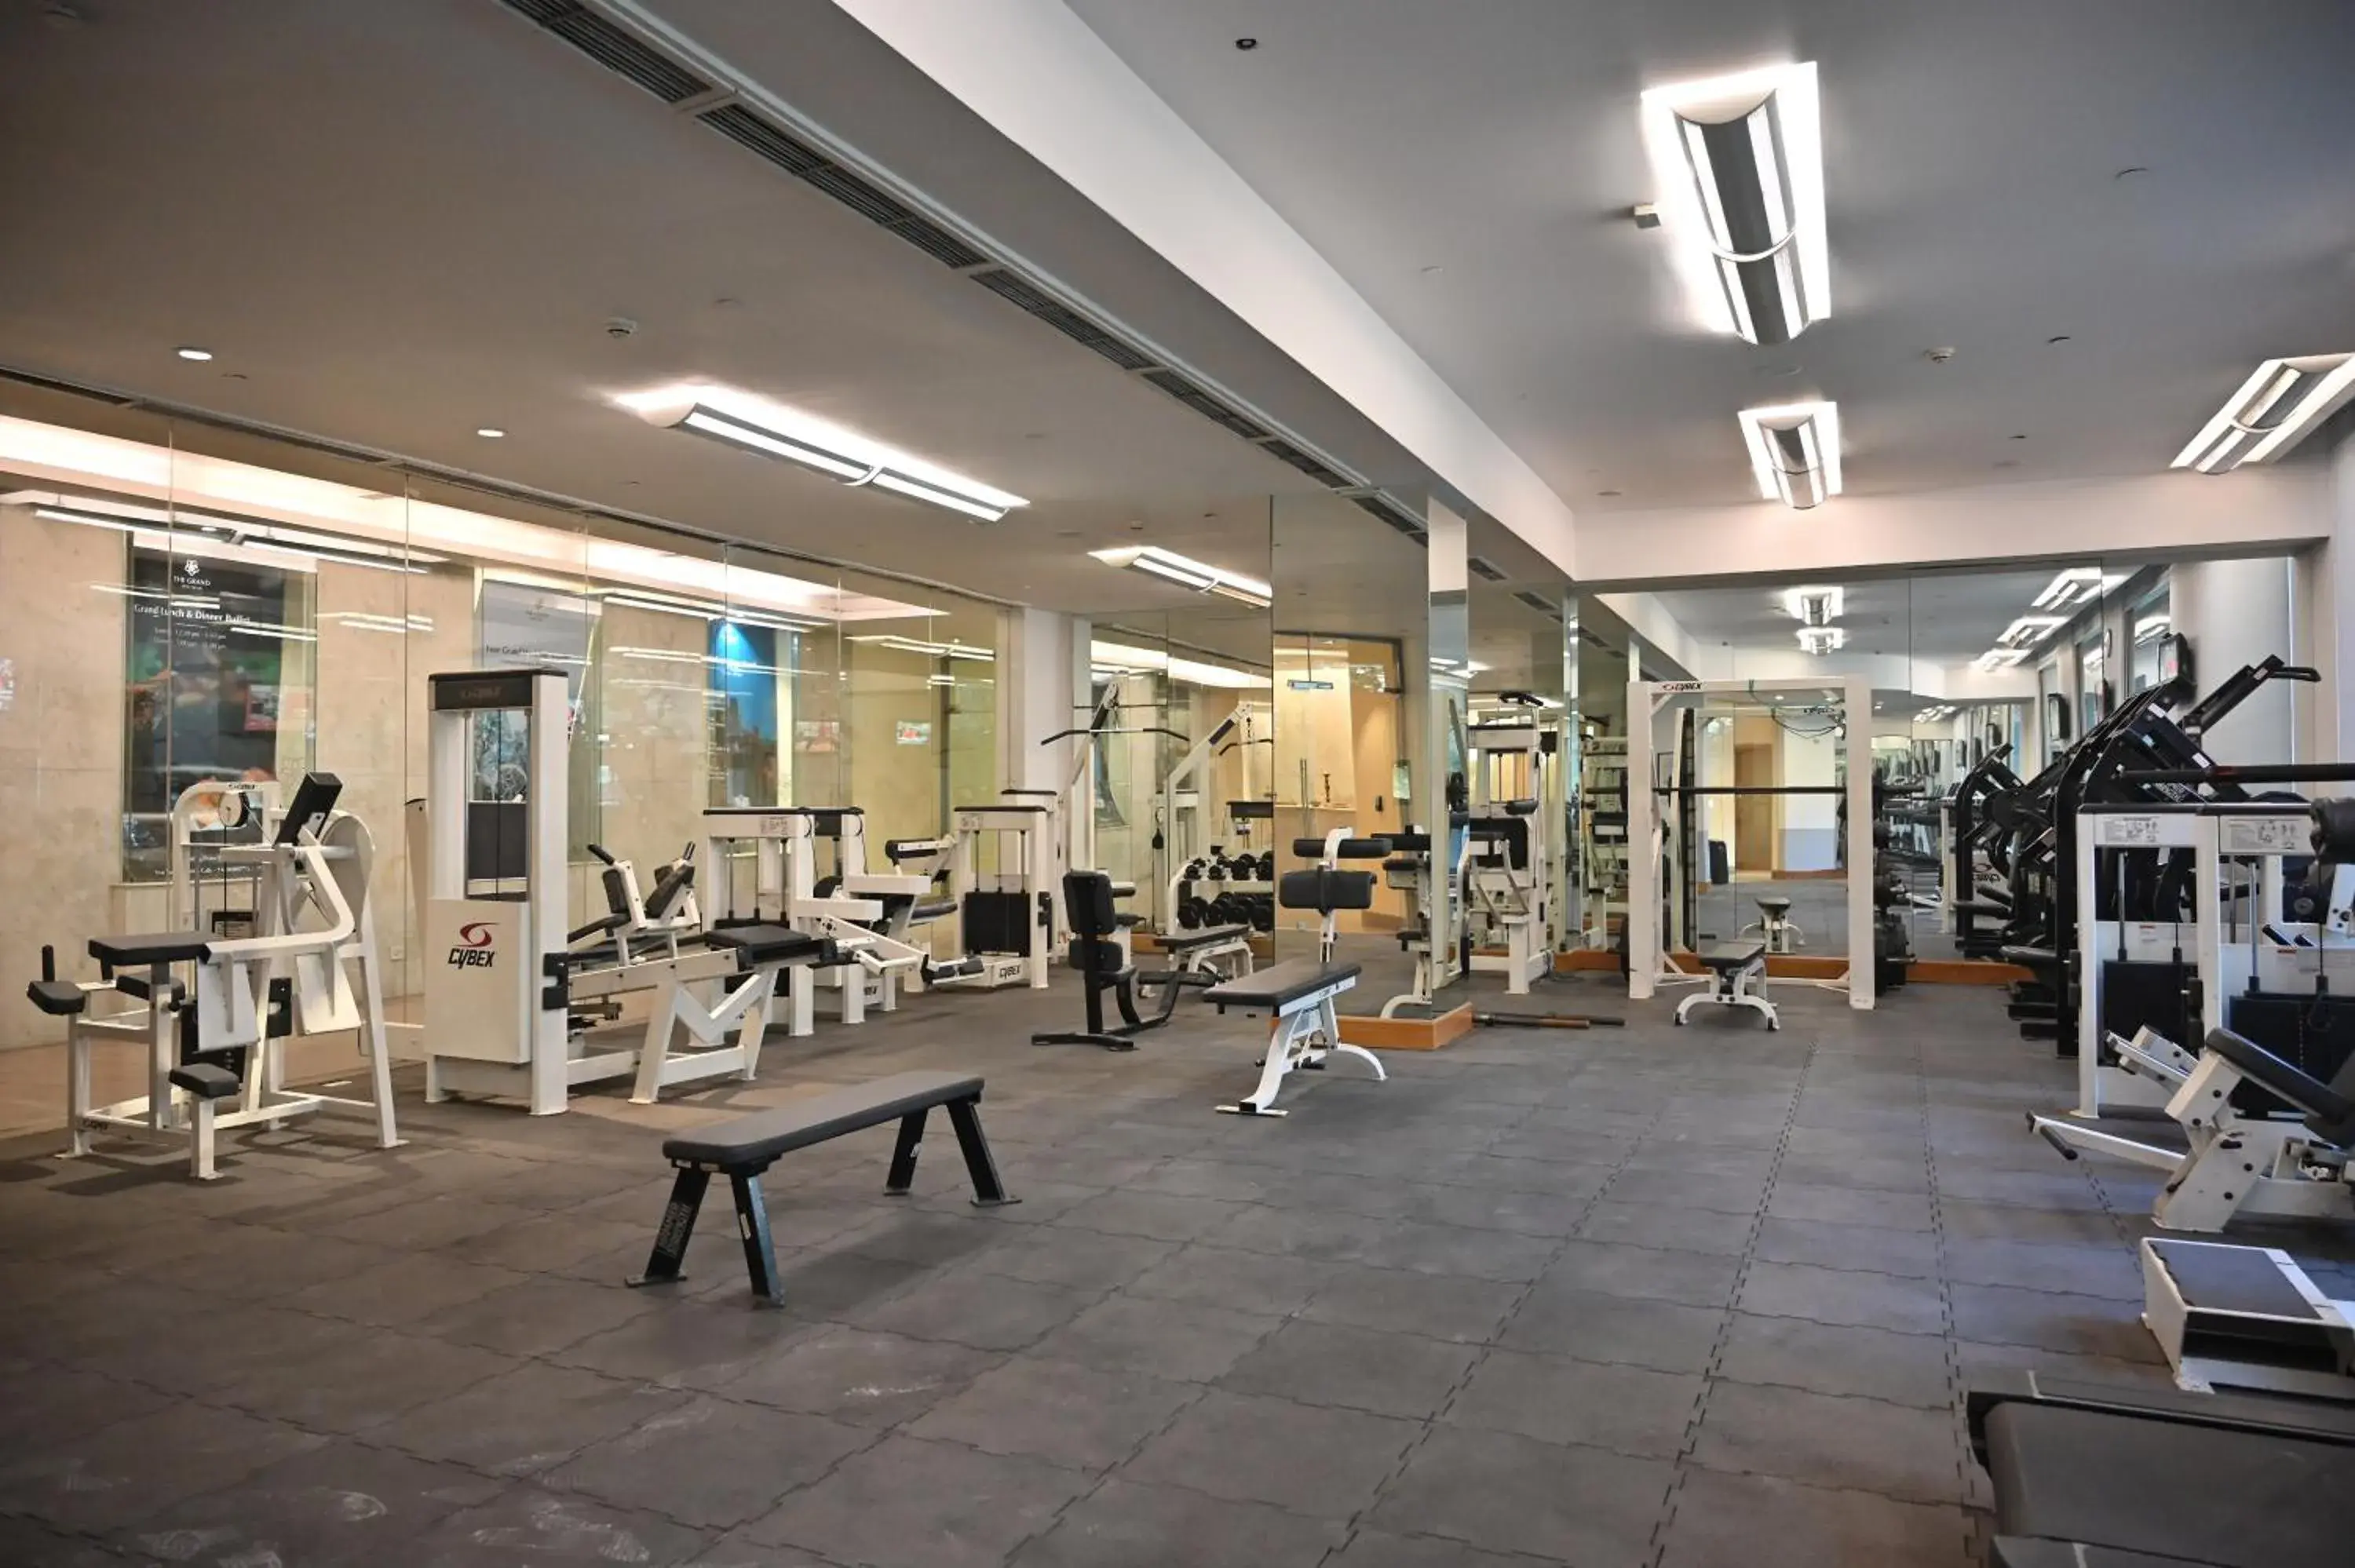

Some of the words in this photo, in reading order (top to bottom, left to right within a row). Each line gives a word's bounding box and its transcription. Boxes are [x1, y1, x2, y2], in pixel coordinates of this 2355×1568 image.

[186, 577, 211, 586] GRAND
[134, 604, 159, 614] Grand
[161, 606, 184, 618] Lunch
[185, 610, 194, 619] &
[195, 611, 223, 622] Dinner
[448, 947, 495, 970] CYBEX
